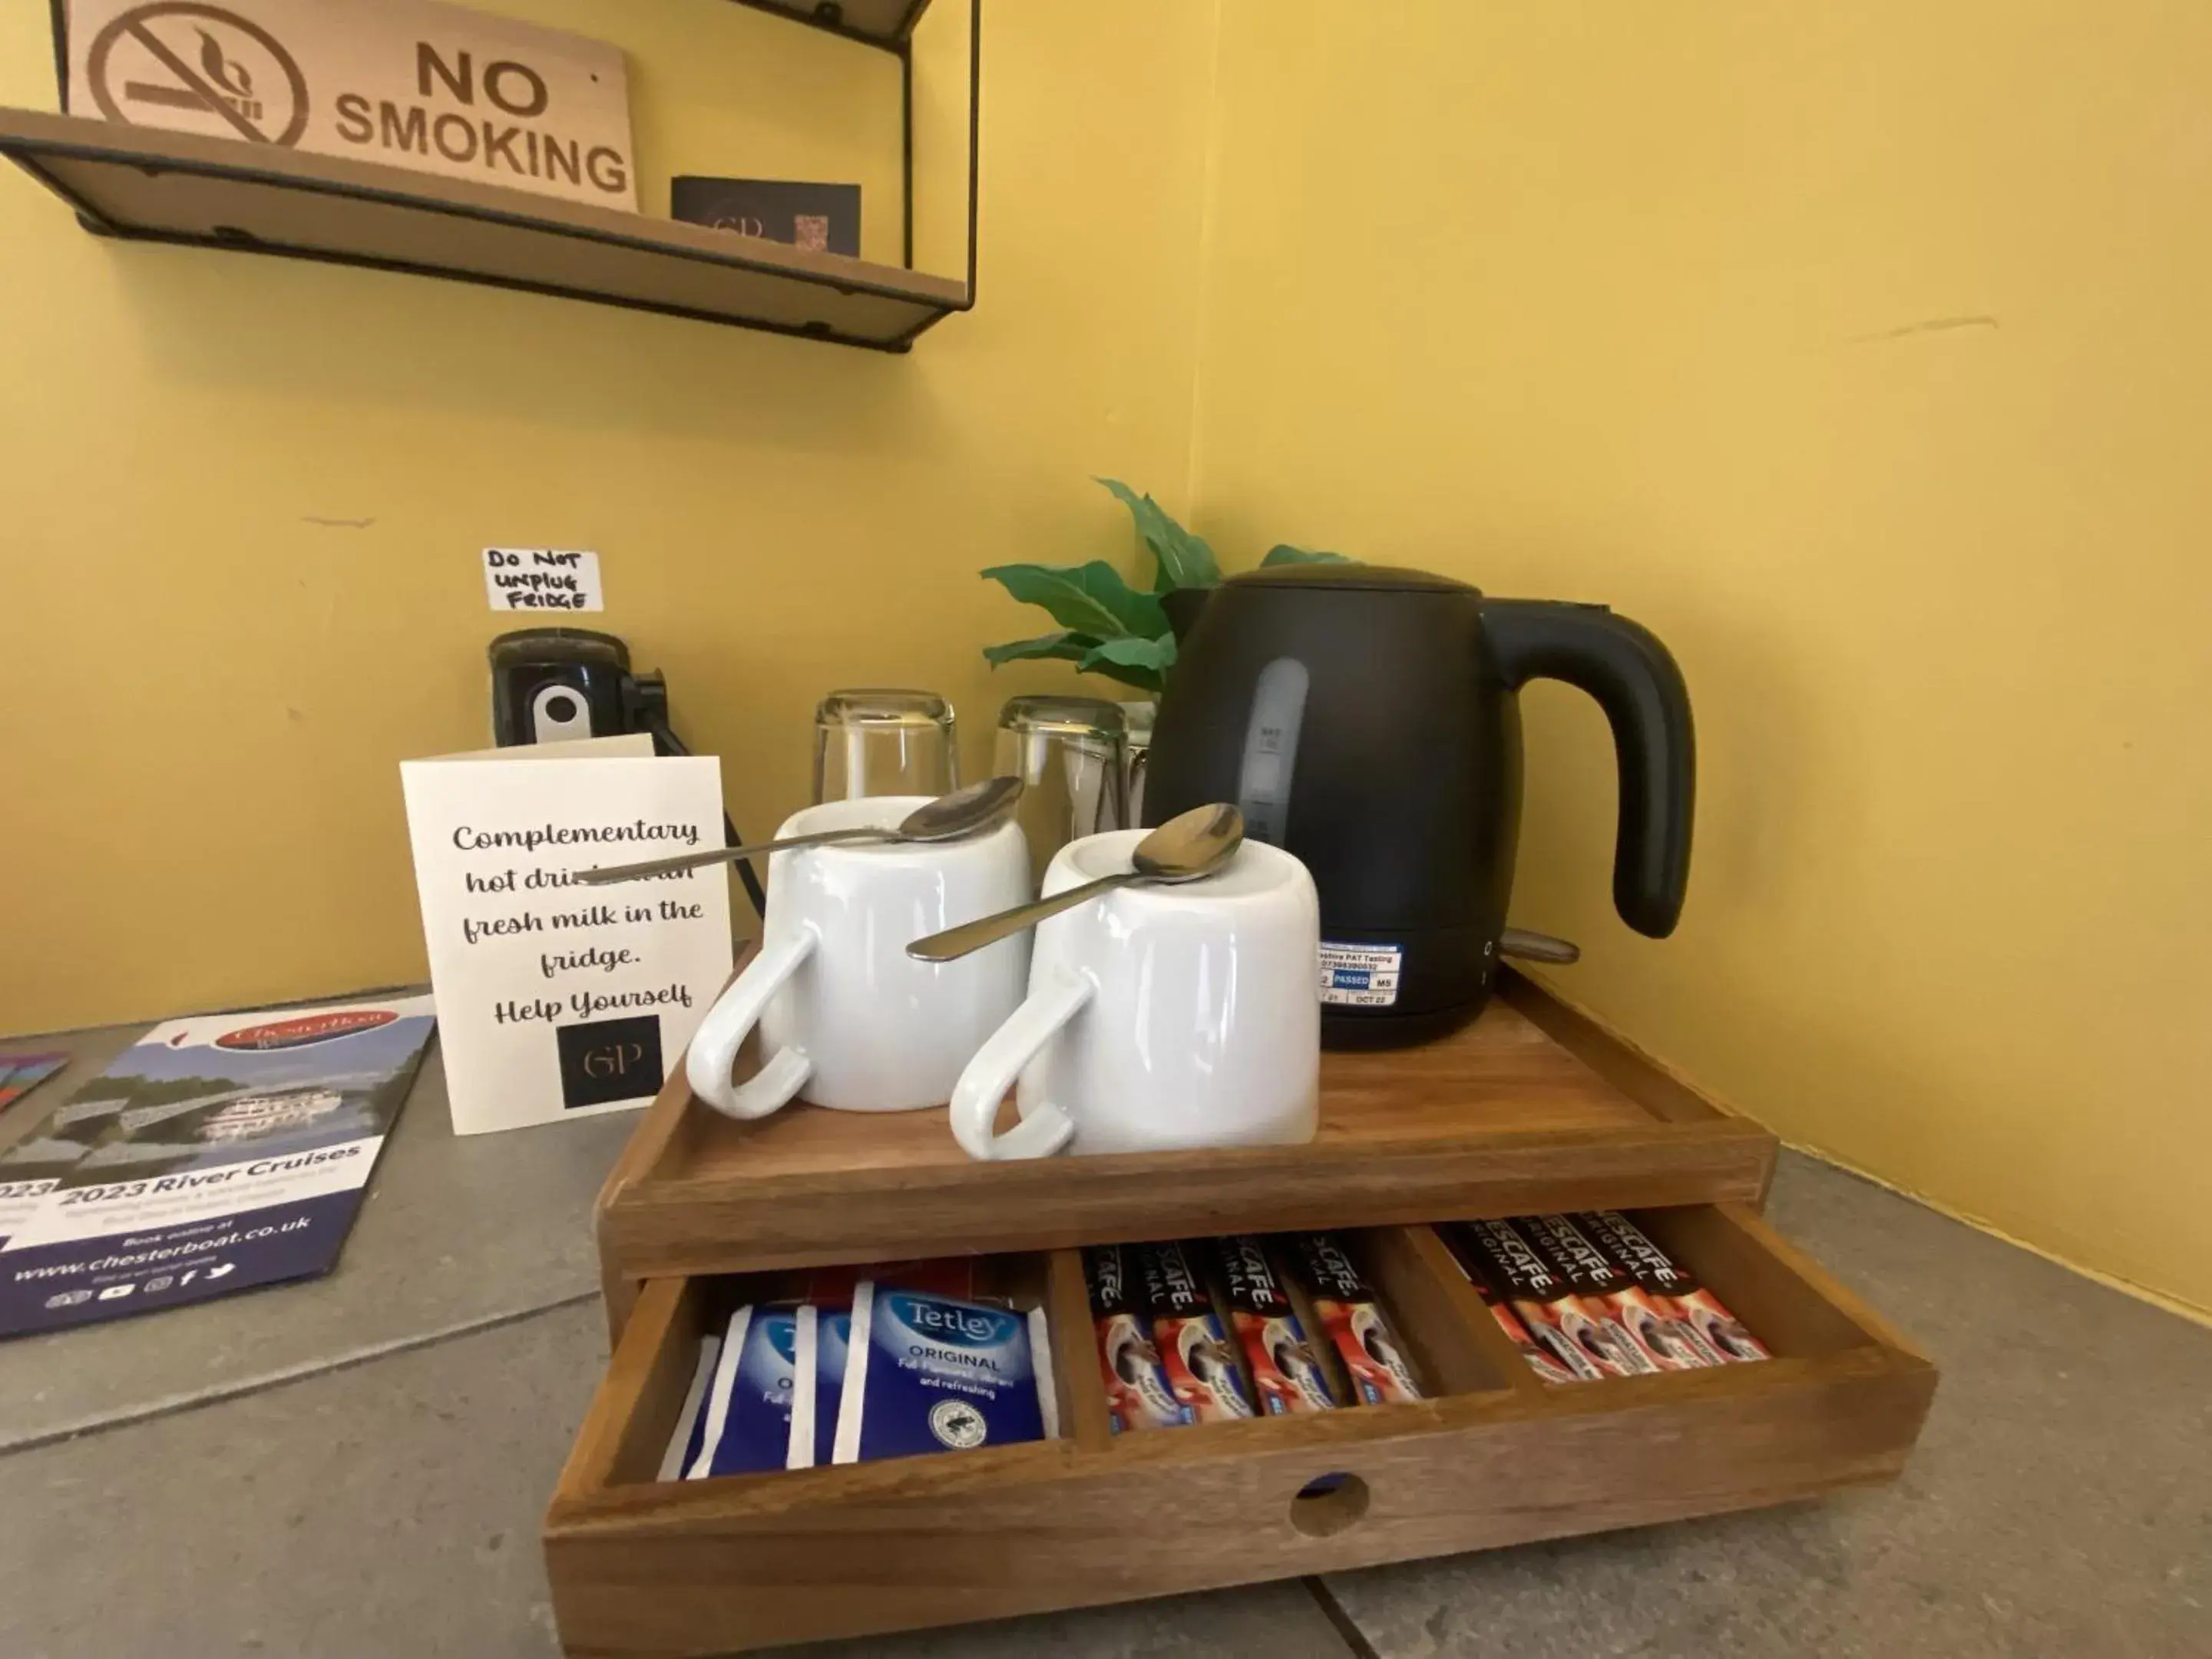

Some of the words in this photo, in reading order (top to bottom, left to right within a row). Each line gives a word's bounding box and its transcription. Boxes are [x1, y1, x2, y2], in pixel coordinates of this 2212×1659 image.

[416, 41, 549, 117] NO
[334, 93, 628, 194] SMOKING
[453, 820, 700, 851] Complementary
[465, 869, 516, 893] hot
[464, 912, 544, 944] fresh
[551, 906, 619, 930] milk
[625, 905, 653, 923] in
[658, 900, 704, 920] the
[541, 947, 642, 978] fridge.
[1334, 976, 1369, 985] PASSED
[494, 1000, 562, 1024] Help
[571, 983, 693, 1018] Yourself
[59, 1183, 147, 1206] 2023
[153, 1168, 241, 1195] River
[247, 1145, 362, 1176] Cruises
[14, 1216, 312, 1282] www.chesterboat.co.uk
[1470, 1223, 1525, 1287] RIGINAL
[906, 1301, 1006, 1340] Tetley
[909, 1345, 1001, 1373] ORIGINAL
[919, 1376, 940, 1388] and
[941, 1379, 997, 1401] refreshing
